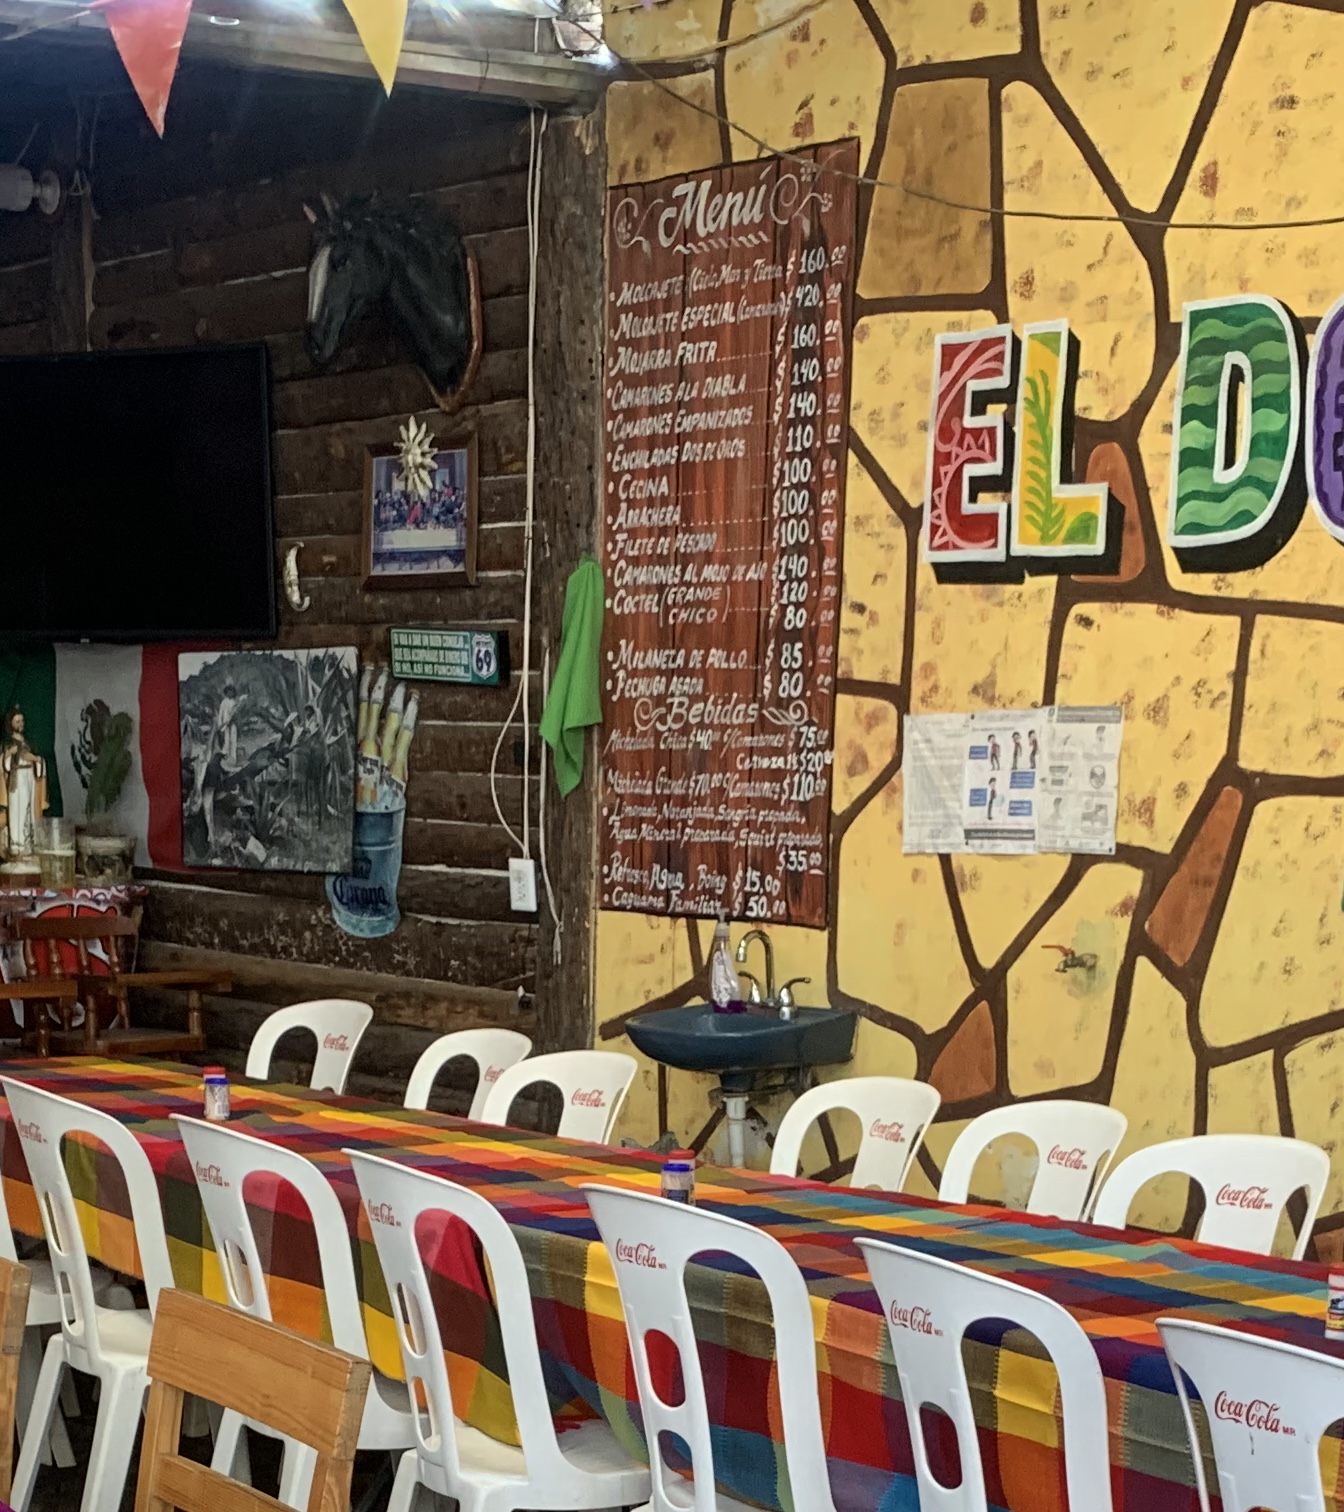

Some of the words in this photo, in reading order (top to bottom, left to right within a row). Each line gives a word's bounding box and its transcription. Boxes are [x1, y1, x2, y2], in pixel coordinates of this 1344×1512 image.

[658, 165, 773, 248] Menú
[616, 274, 684, 307] MOLCAJETE
[614, 311, 679, 341] MOLCAJETE
[681, 301, 736, 331] ESPECIAL
[609, 345, 671, 377] MOJARRA
[674, 340, 717, 366] FRITA
[611, 379, 674, 411] CAMARONES
[702, 373, 746, 398] DIABLA
[612, 412, 673, 442] CAMARONES
[674, 405, 753, 434] EMPANIZADOS
[612, 443, 679, 473] ENCHILADAS
[681, 440, 703, 463] DOS
[704, 440, 716, 461] DE
[717, 437, 746, 461] OROS
[923, 318, 1114, 568] EL
[618, 473, 669, 500] CECINA
[612, 502, 681, 531] ARRACHERA
[610, 532, 655, 560] FILETE
[656, 536, 671, 555] DE
[614, 559, 682, 588] CAMARONES
[683, 562, 698, 584] AL
[700, 563, 730, 583] MOJO
[732, 564, 746, 582] DE
[746, 561, 768, 582] AJO
[613, 588, 659, 615] COCTEL
[476, 649, 492, 672] 69
[688, 649, 704, 669] DE
[706, 647, 747, 669] POLLO
[612, 669, 666, 701] PECHUGA
[668, 675, 704, 696] ASADA
[655, 692, 758, 731] Bebidas
[736, 753, 785, 770] Cerveza
[1047, 1144, 1085, 1170] Coca-Cola
[1216, 1183, 1268, 1209] Coca-Cola
[616, 1238, 657, 1268] Coca-Cola
[890, 1299, 933, 1335] Coca-Cola
[1215, 1390, 1281, 1432] Coca-Cola
